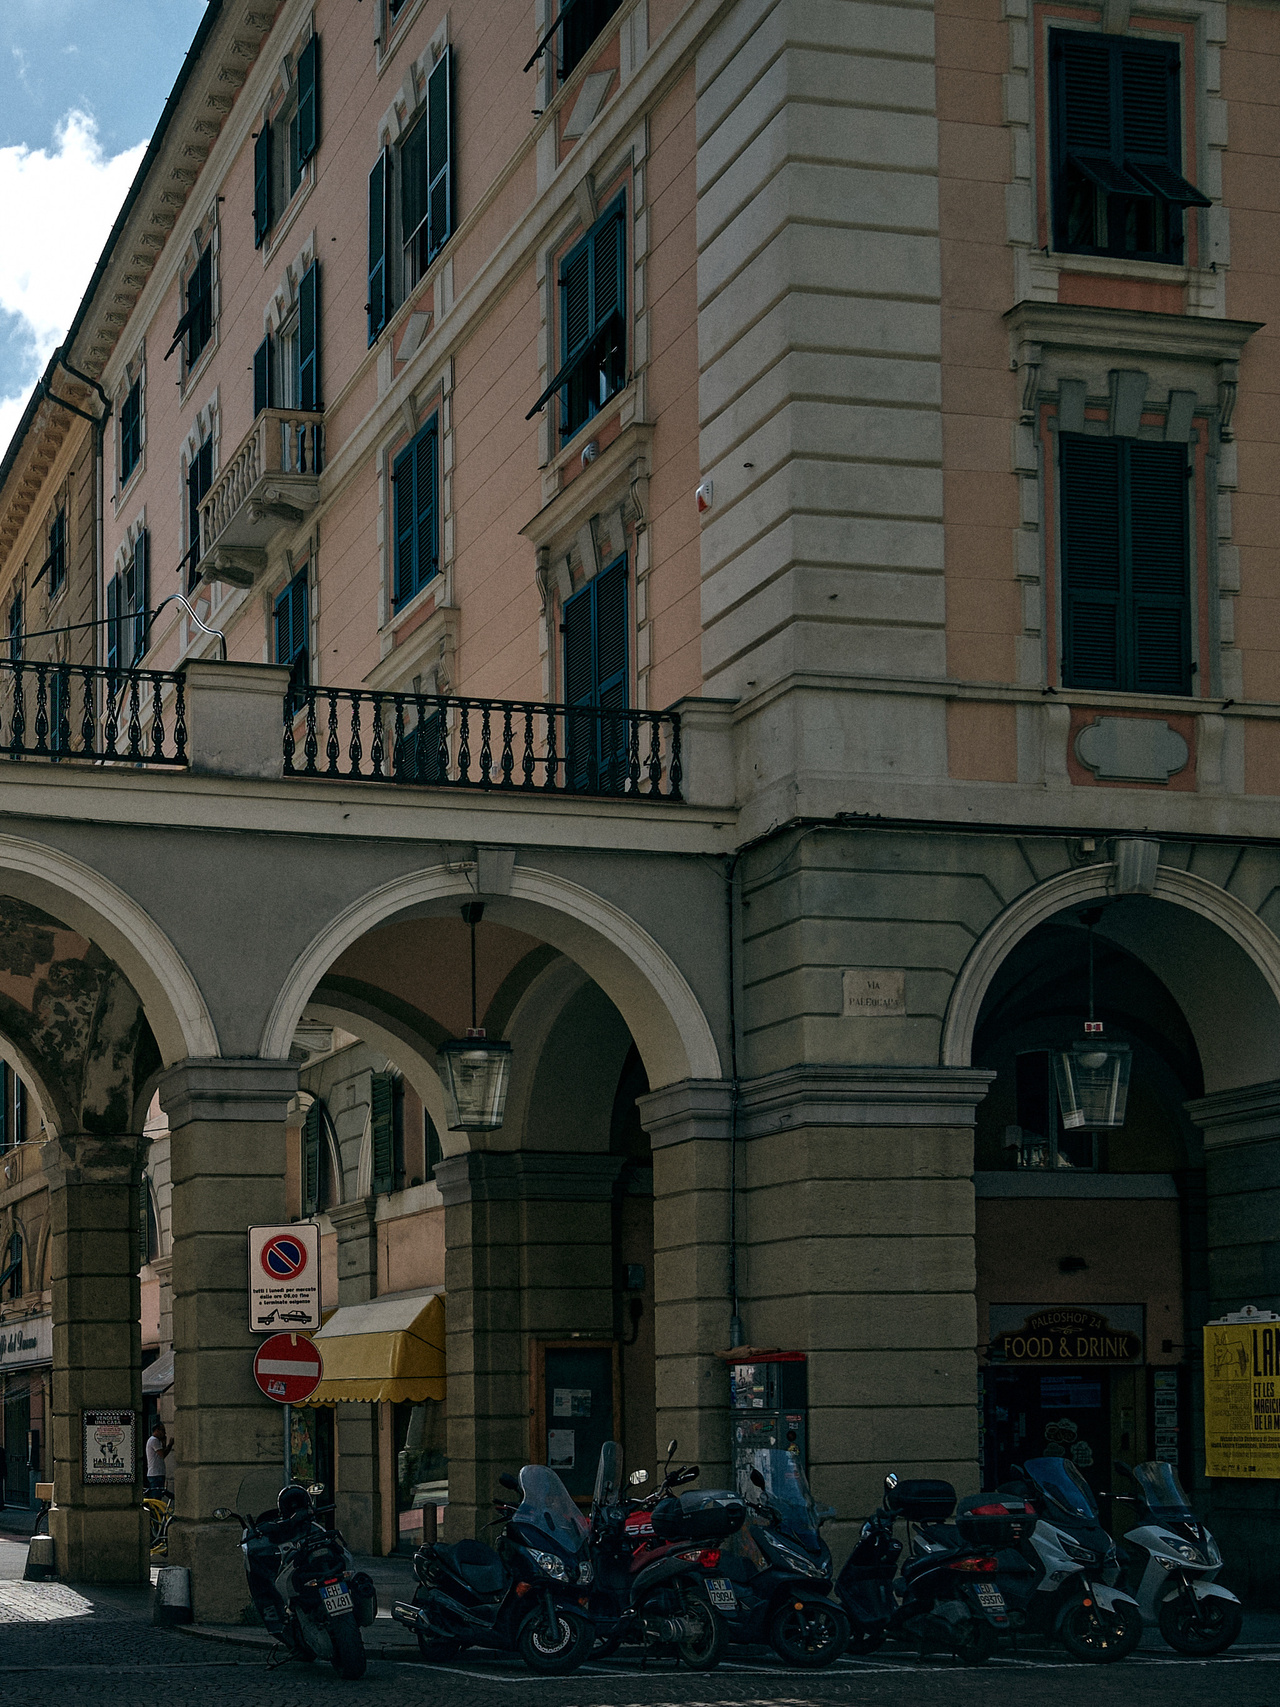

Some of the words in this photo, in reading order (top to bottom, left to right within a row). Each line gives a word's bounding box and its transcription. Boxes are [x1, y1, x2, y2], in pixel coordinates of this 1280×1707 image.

[867, 981, 880, 989] VIA
[1031, 1311, 1088, 1330] PALEOSHOP
[1088, 1317, 1102, 1329] 24
[1004, 1337, 1054, 1358] FOOD
[1060, 1336, 1073, 1358] &
[1077, 1337, 1130, 1358] DRINK
[1254, 1383, 1262, 1397] ET
[1263, 1382, 1275, 1397] LES
[1255, 1415, 1263, 1430] DE
[1265, 1415, 1273, 1429] LA
[326, 1595, 351, 1611] 81481
